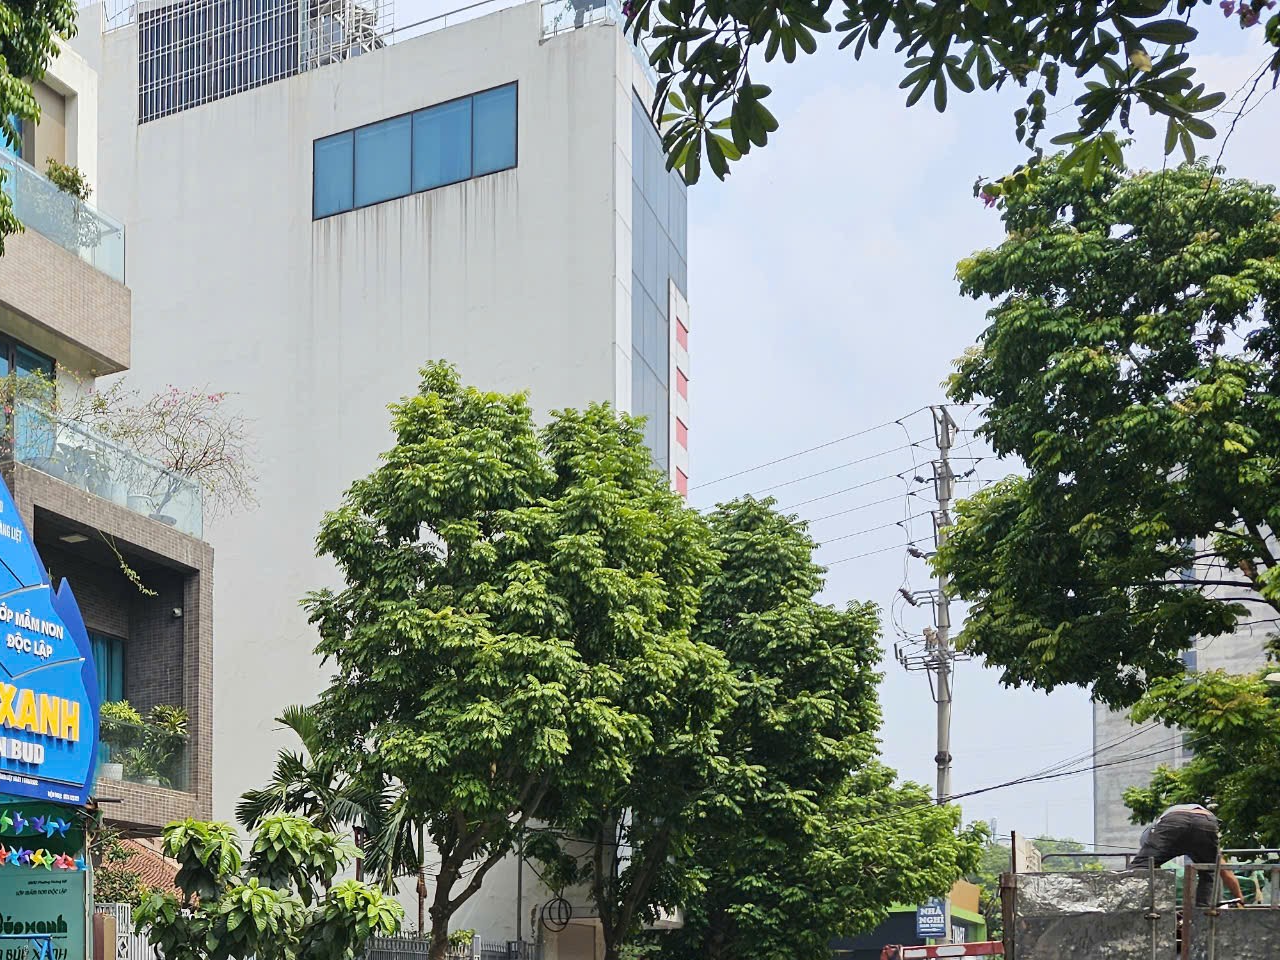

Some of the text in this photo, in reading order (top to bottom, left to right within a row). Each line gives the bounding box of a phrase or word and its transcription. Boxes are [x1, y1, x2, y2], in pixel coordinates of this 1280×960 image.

[15, 608, 40, 633] MẦM
[41, 620, 64, 640] NON
[7, 632, 53, 661] ĐỘC LẬP
[10, 738, 45, 765] BUD
